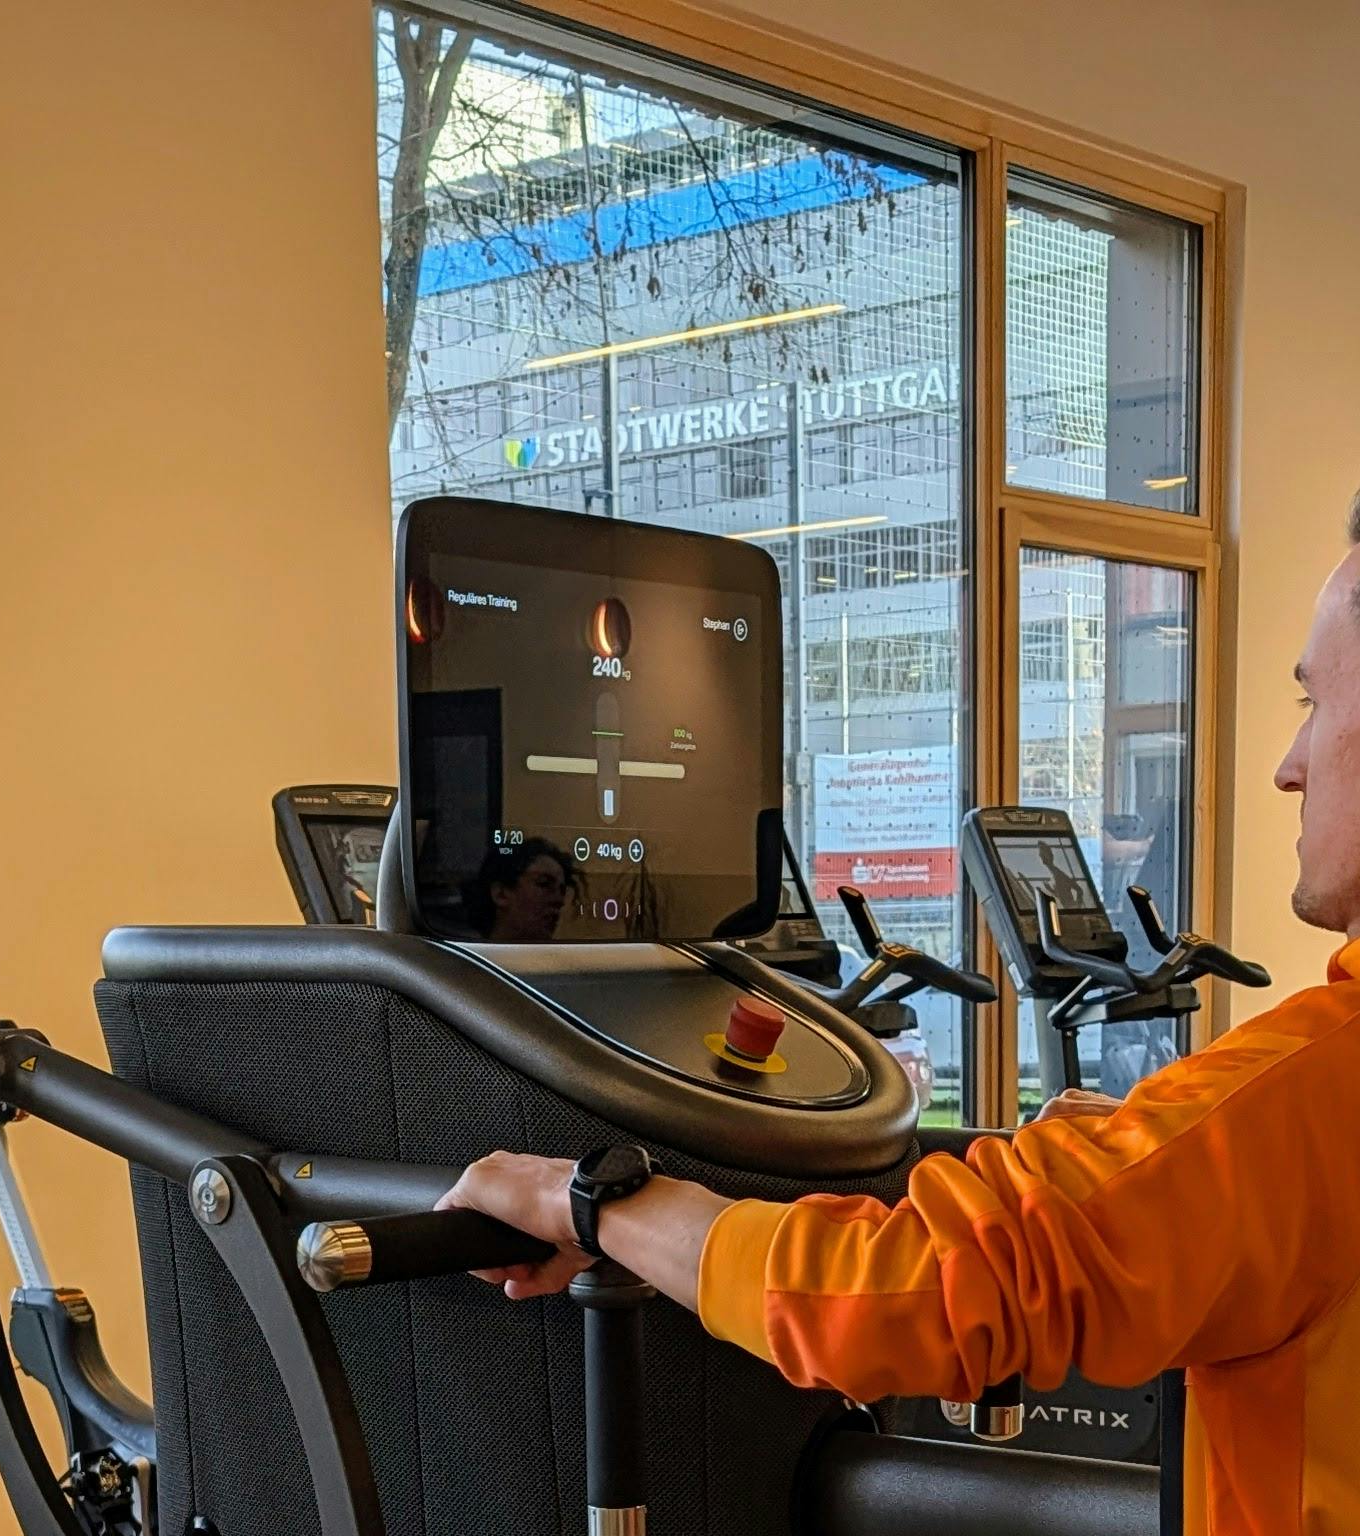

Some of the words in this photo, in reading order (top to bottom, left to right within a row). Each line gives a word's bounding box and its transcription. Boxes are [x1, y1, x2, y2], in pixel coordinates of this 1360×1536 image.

[487, 594, 518, 612] Training
[703, 617, 730, 631] Stephan
[592, 656, 621, 678] 240
[494, 830, 502, 845] 5
[510, 830, 524, 845] 20
[596, 843, 610, 857] 40
[610, 844, 623, 861] kg
[1020, 1403, 1130, 1430] ATRIX
